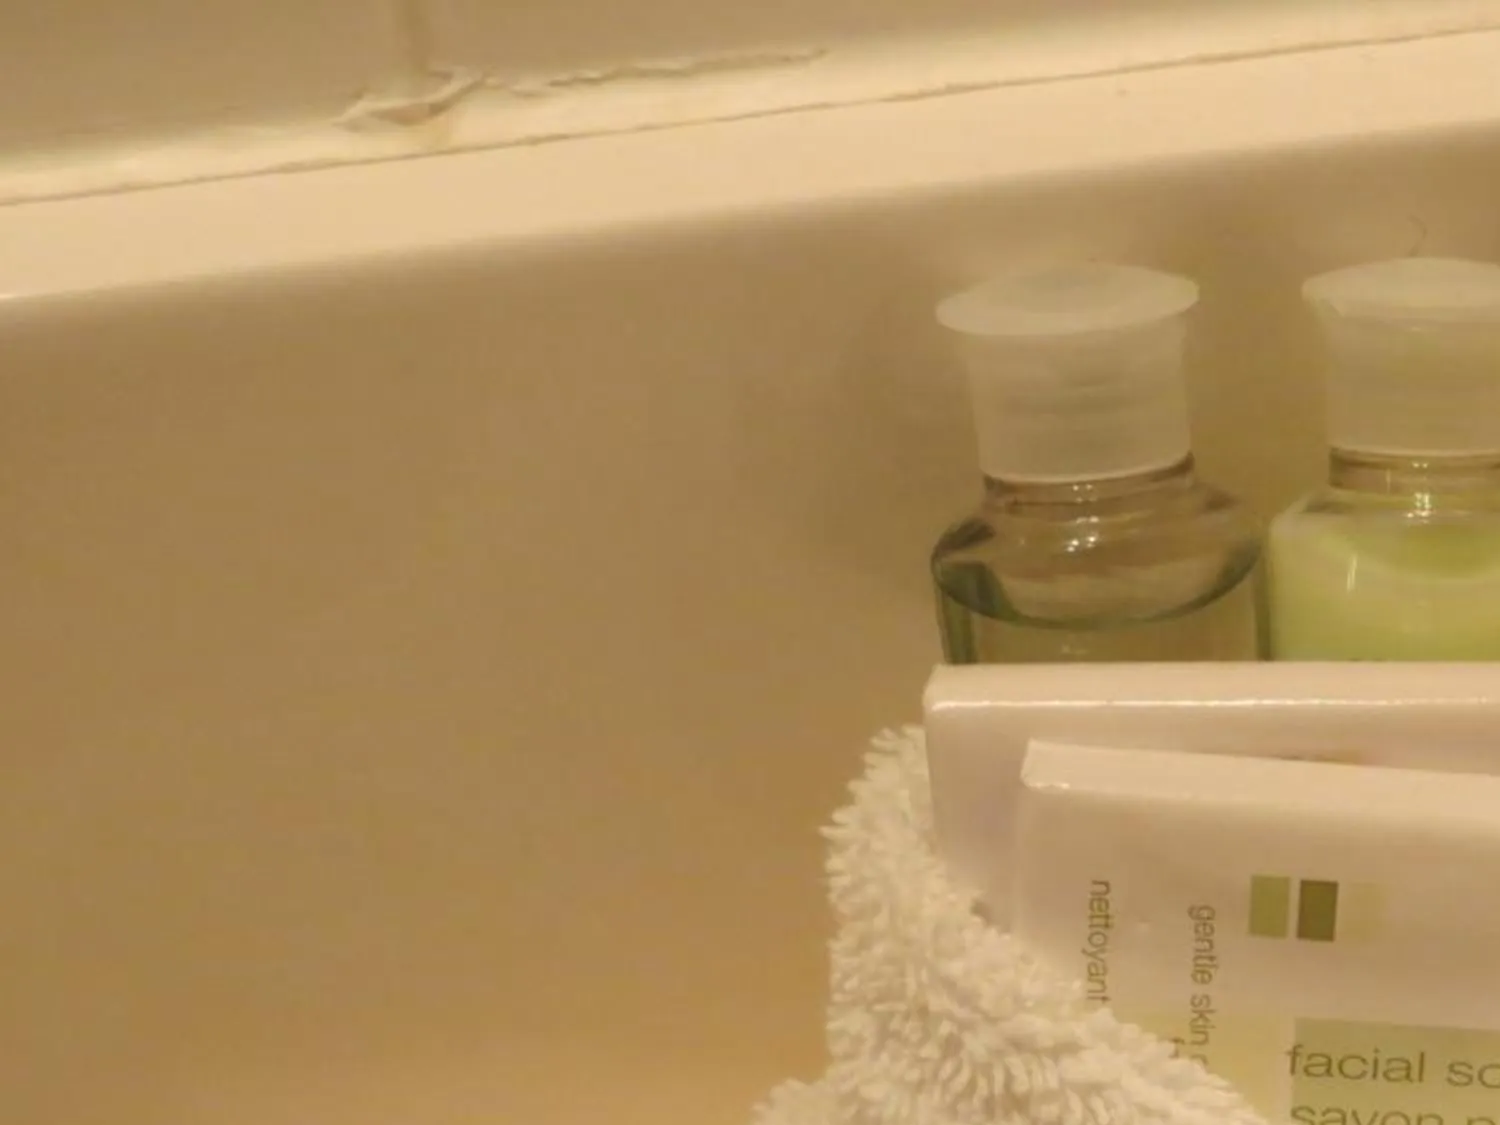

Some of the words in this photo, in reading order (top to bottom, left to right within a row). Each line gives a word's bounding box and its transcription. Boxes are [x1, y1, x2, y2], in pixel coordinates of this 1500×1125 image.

[1081, 879, 1112, 1004] nettoyant
[1187, 905, 1219, 986] gentle
[1189, 994, 1217, 1046] skin
[1286, 1044, 1426, 1084] facial
